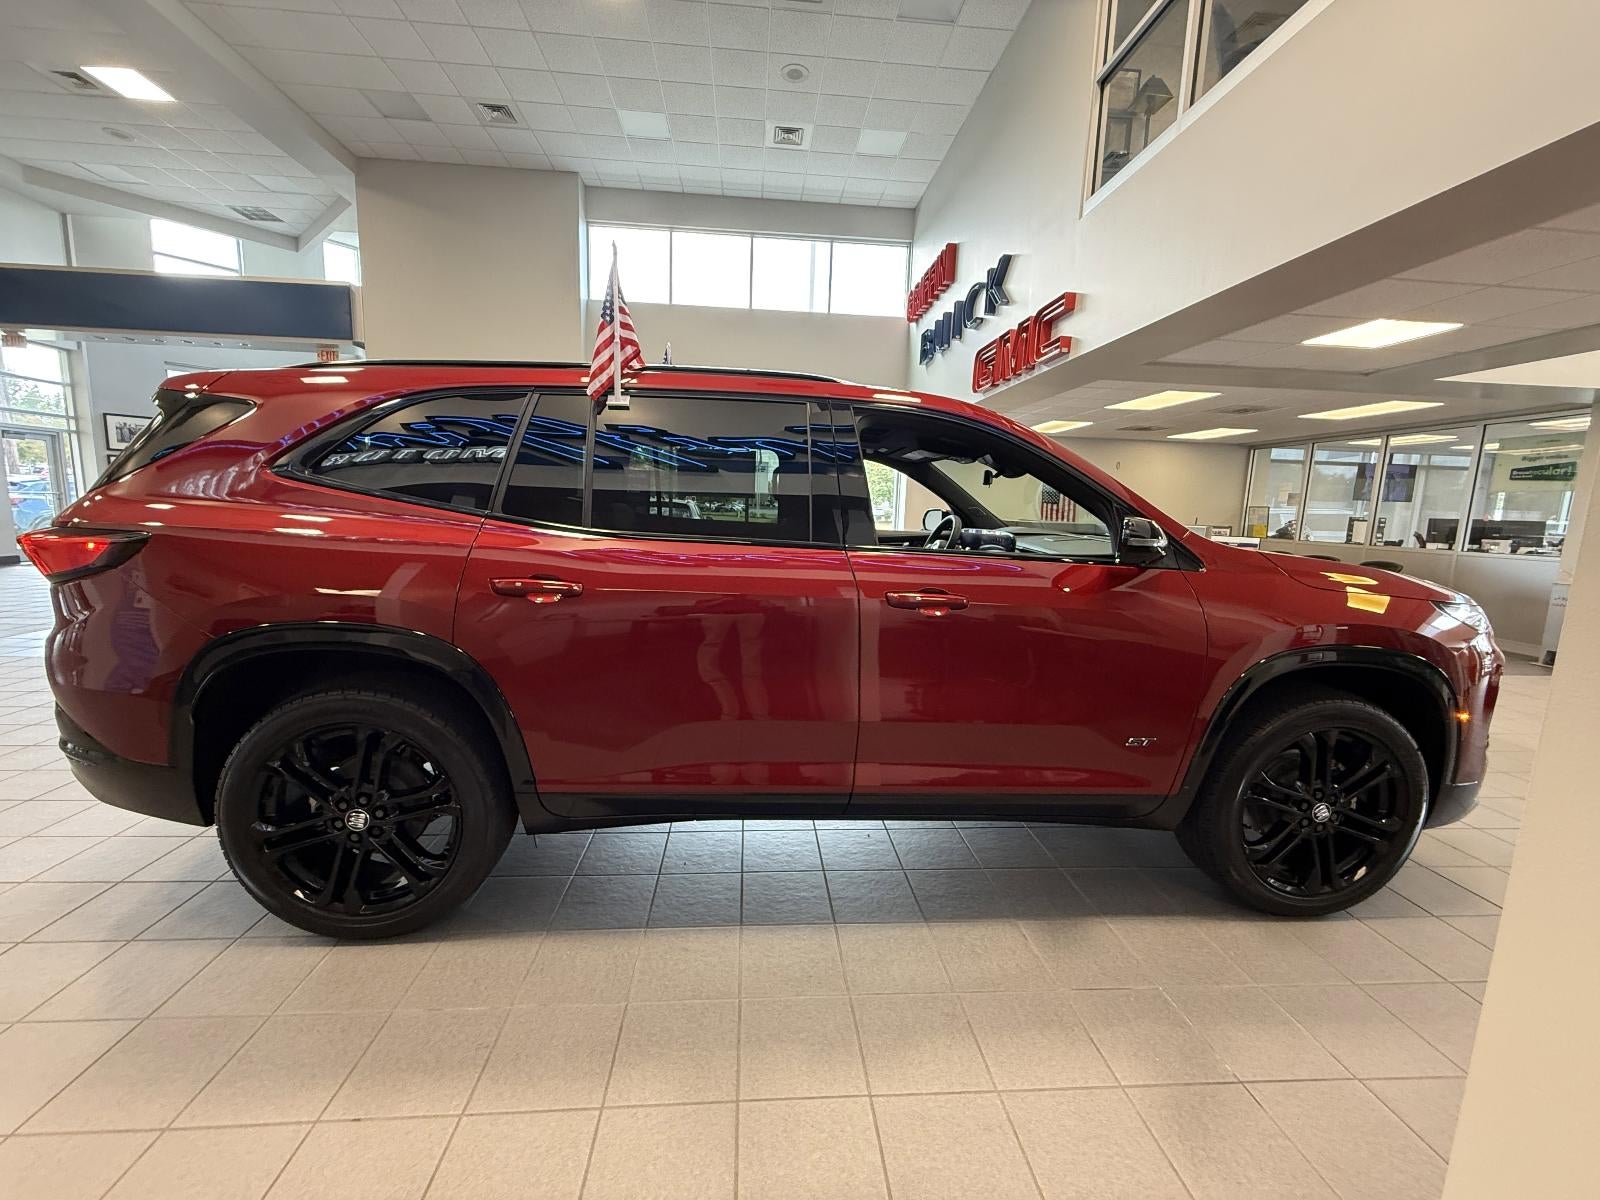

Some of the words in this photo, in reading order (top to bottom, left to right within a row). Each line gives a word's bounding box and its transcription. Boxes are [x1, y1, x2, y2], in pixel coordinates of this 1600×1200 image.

[320, 350, 337, 361] EXIT
[919, 254, 1013, 366] BUICK
[972, 292, 1077, 393] GMC
